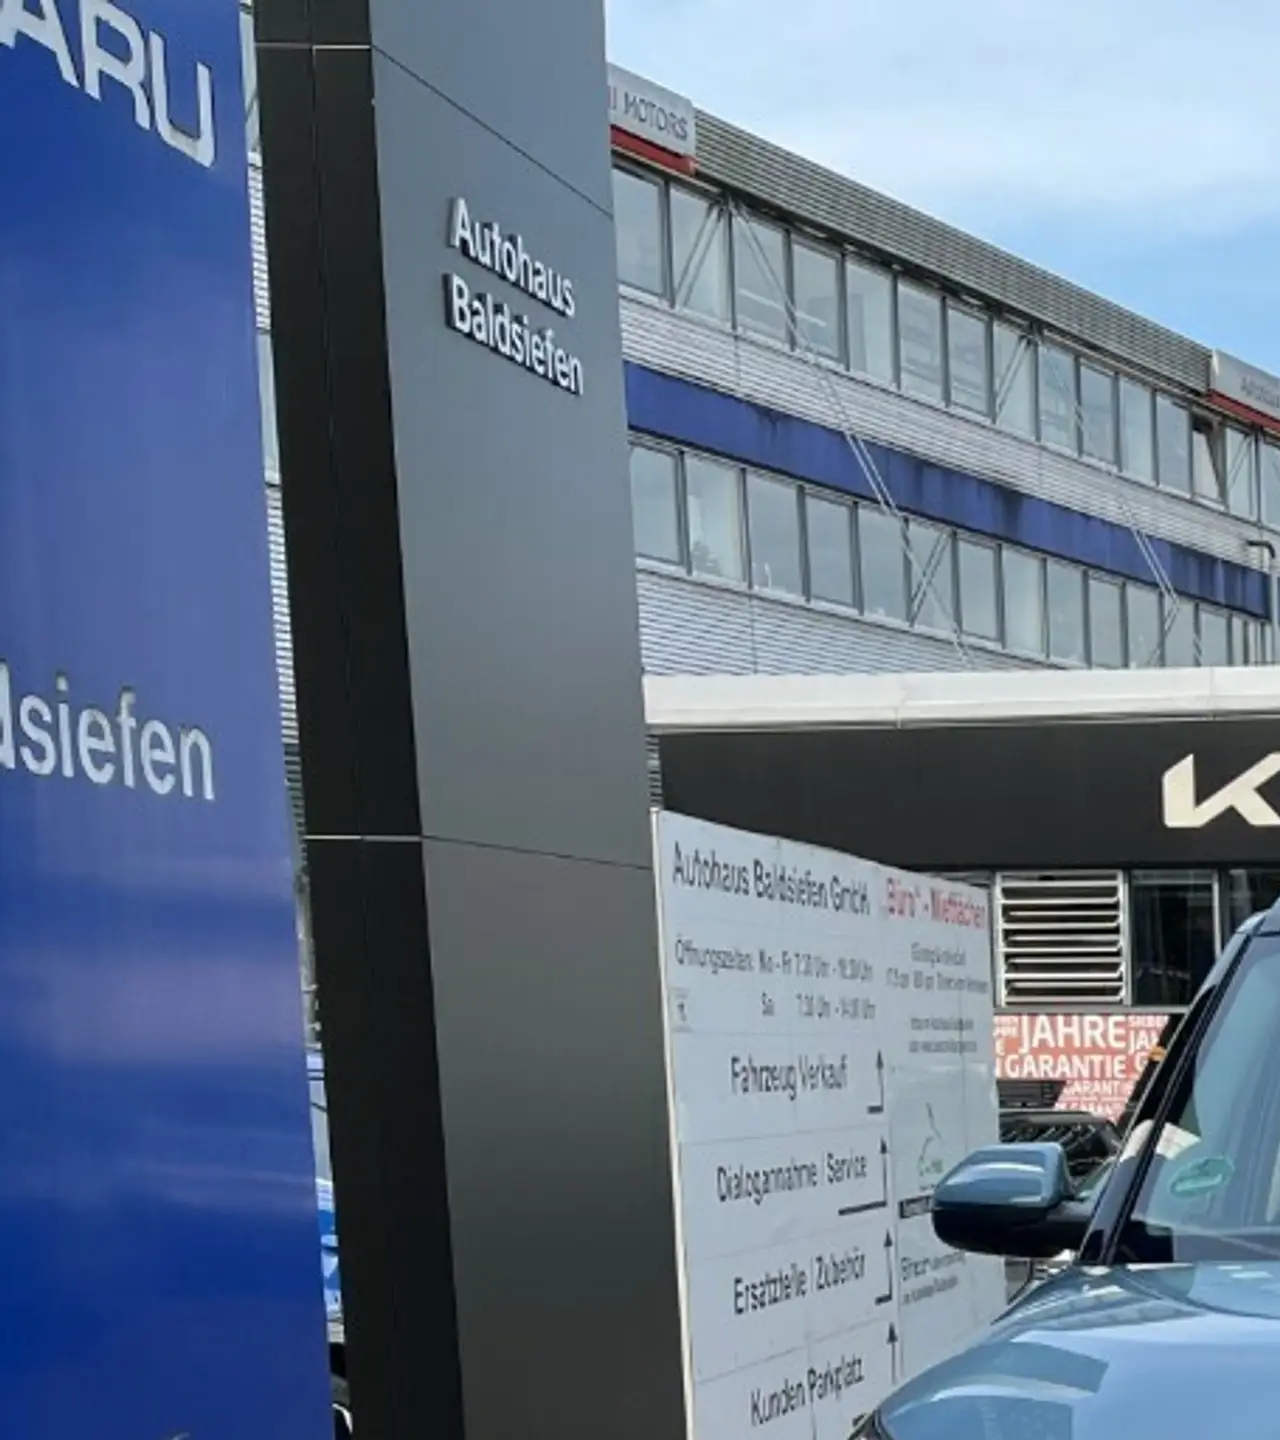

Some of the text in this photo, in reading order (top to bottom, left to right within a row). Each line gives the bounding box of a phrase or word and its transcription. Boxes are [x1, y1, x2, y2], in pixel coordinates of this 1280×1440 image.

[624, 91, 688, 140] MOTORS
[450, 197, 575, 317] Autohaus
[446, 273, 584, 395] Baldsiefen
[673, 841, 871, 916] Autohaus Baldsiefen GmbH
[1019, 1014, 1127, 1054] JAHRE
[731, 1053, 848, 1101] Fahrzeug Verkauf
[1005, 1055, 1127, 1078] GARANTIE
[717, 1156, 818, 1206] Dialogannahme
[827, 1150, 868, 1185] Service
[734, 1262, 808, 1316] Ersatzteile
[815, 1246, 866, 1291] Zubehör
[751, 1352, 865, 1427] Kunden Parkplatz
